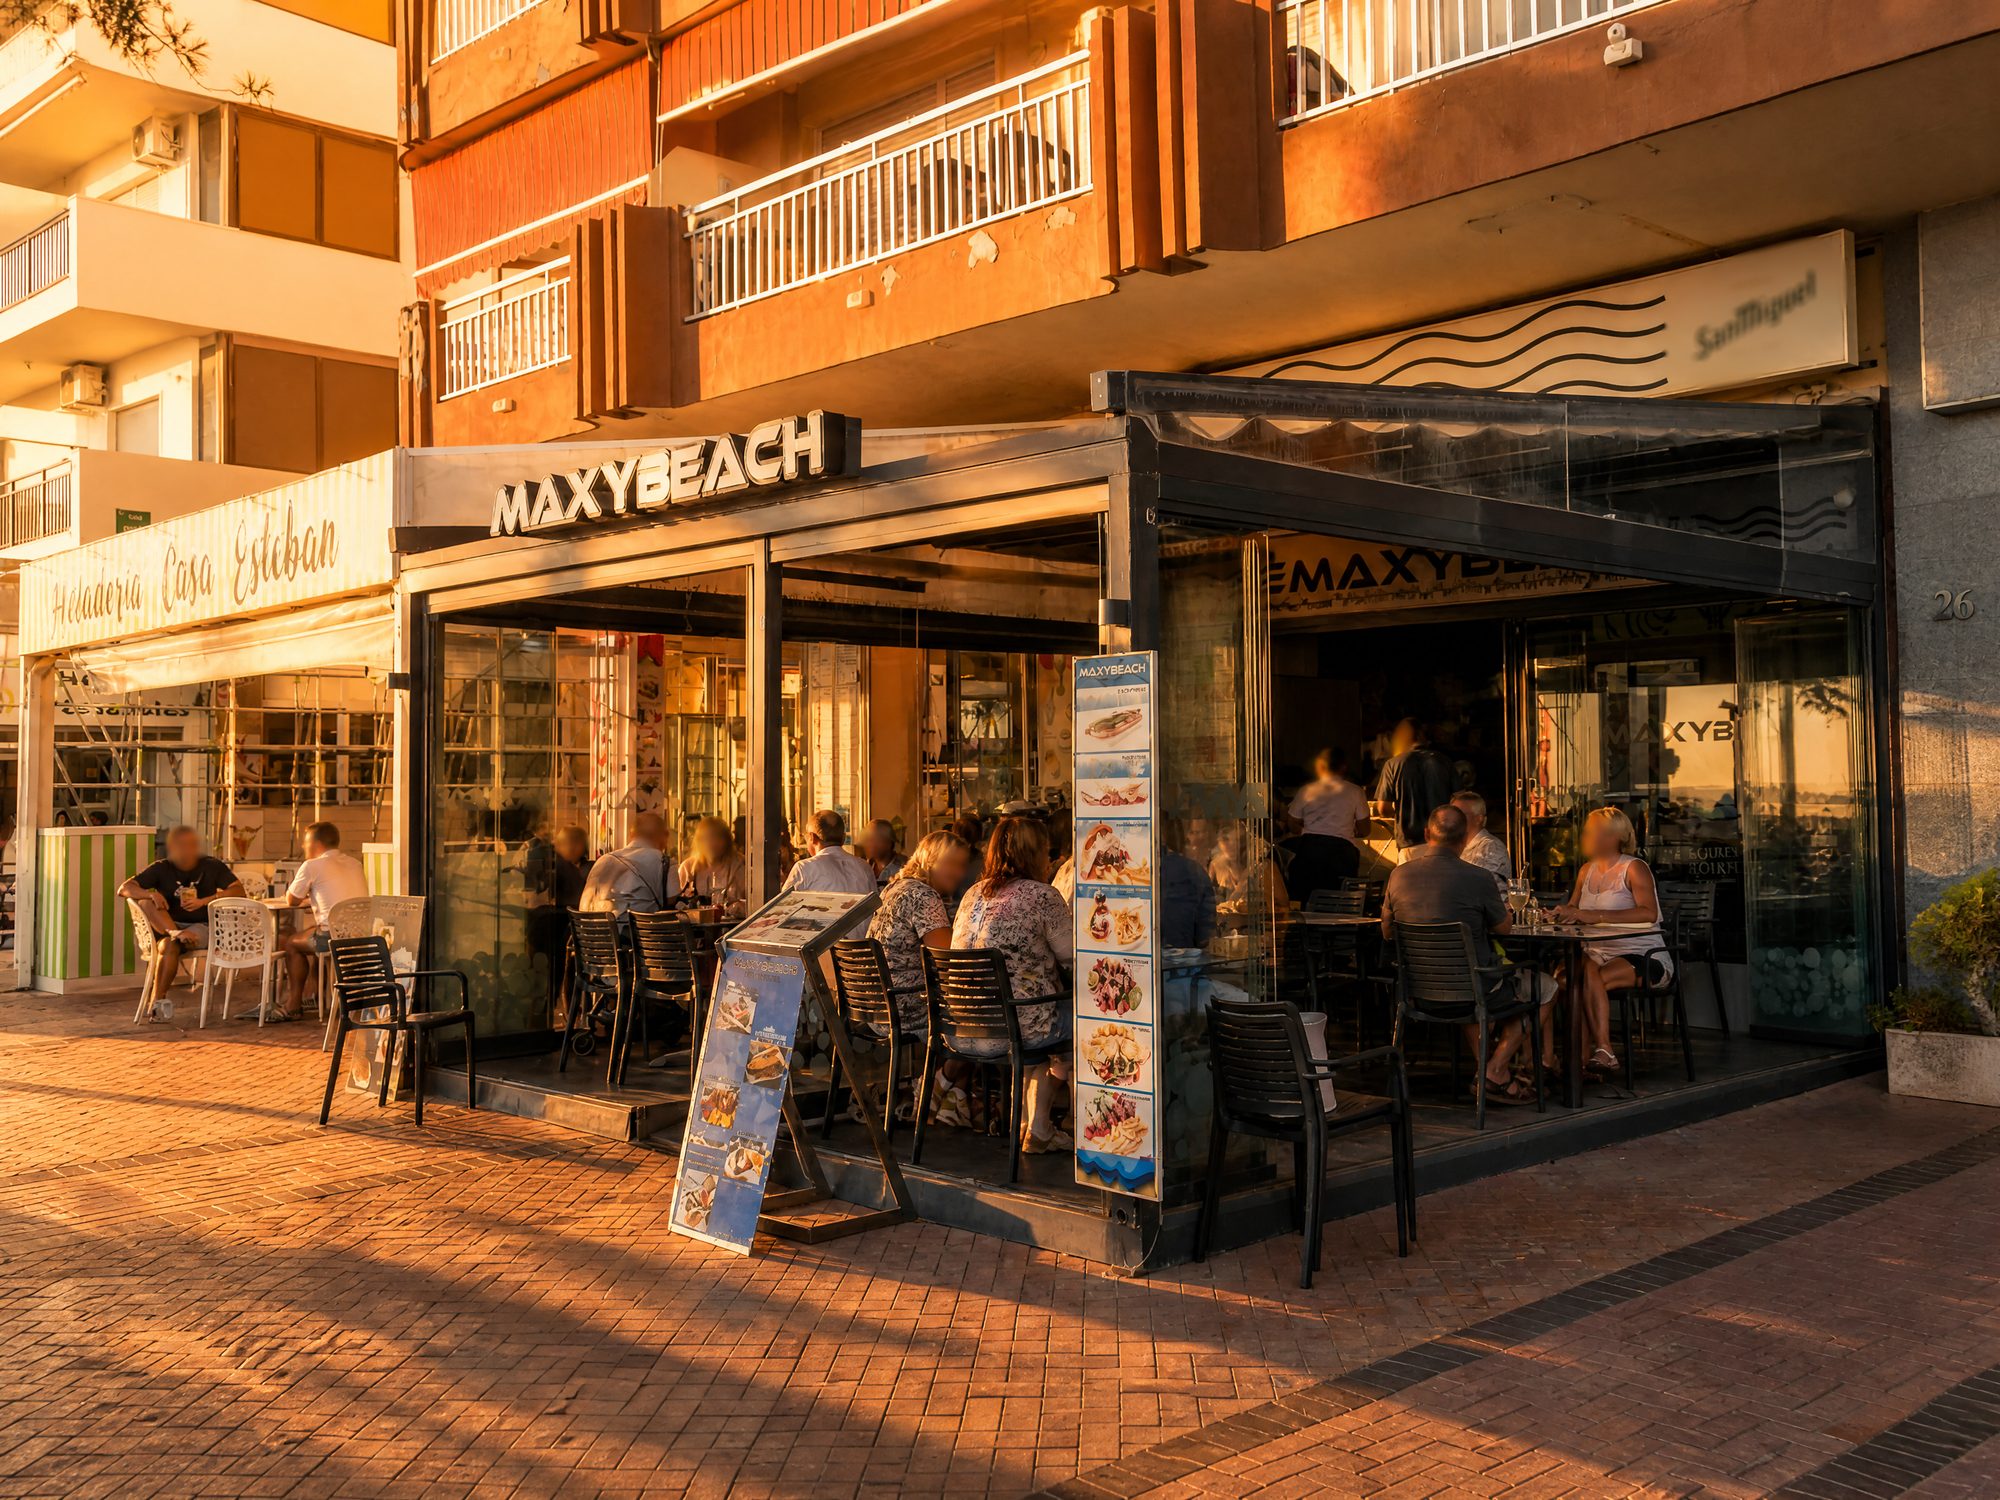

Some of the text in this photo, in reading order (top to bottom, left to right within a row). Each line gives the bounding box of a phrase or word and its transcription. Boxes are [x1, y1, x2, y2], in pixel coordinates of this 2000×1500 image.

[489, 409, 826, 537] MAXYBEACH
[161, 541, 215, 613] Casa
[233, 499, 340, 606] Esteban
[1289, 548, 1540, 593] MAXYB
[1933, 589, 1975, 622] 26
[1079, 662, 1146, 678] MAXYBEACH
